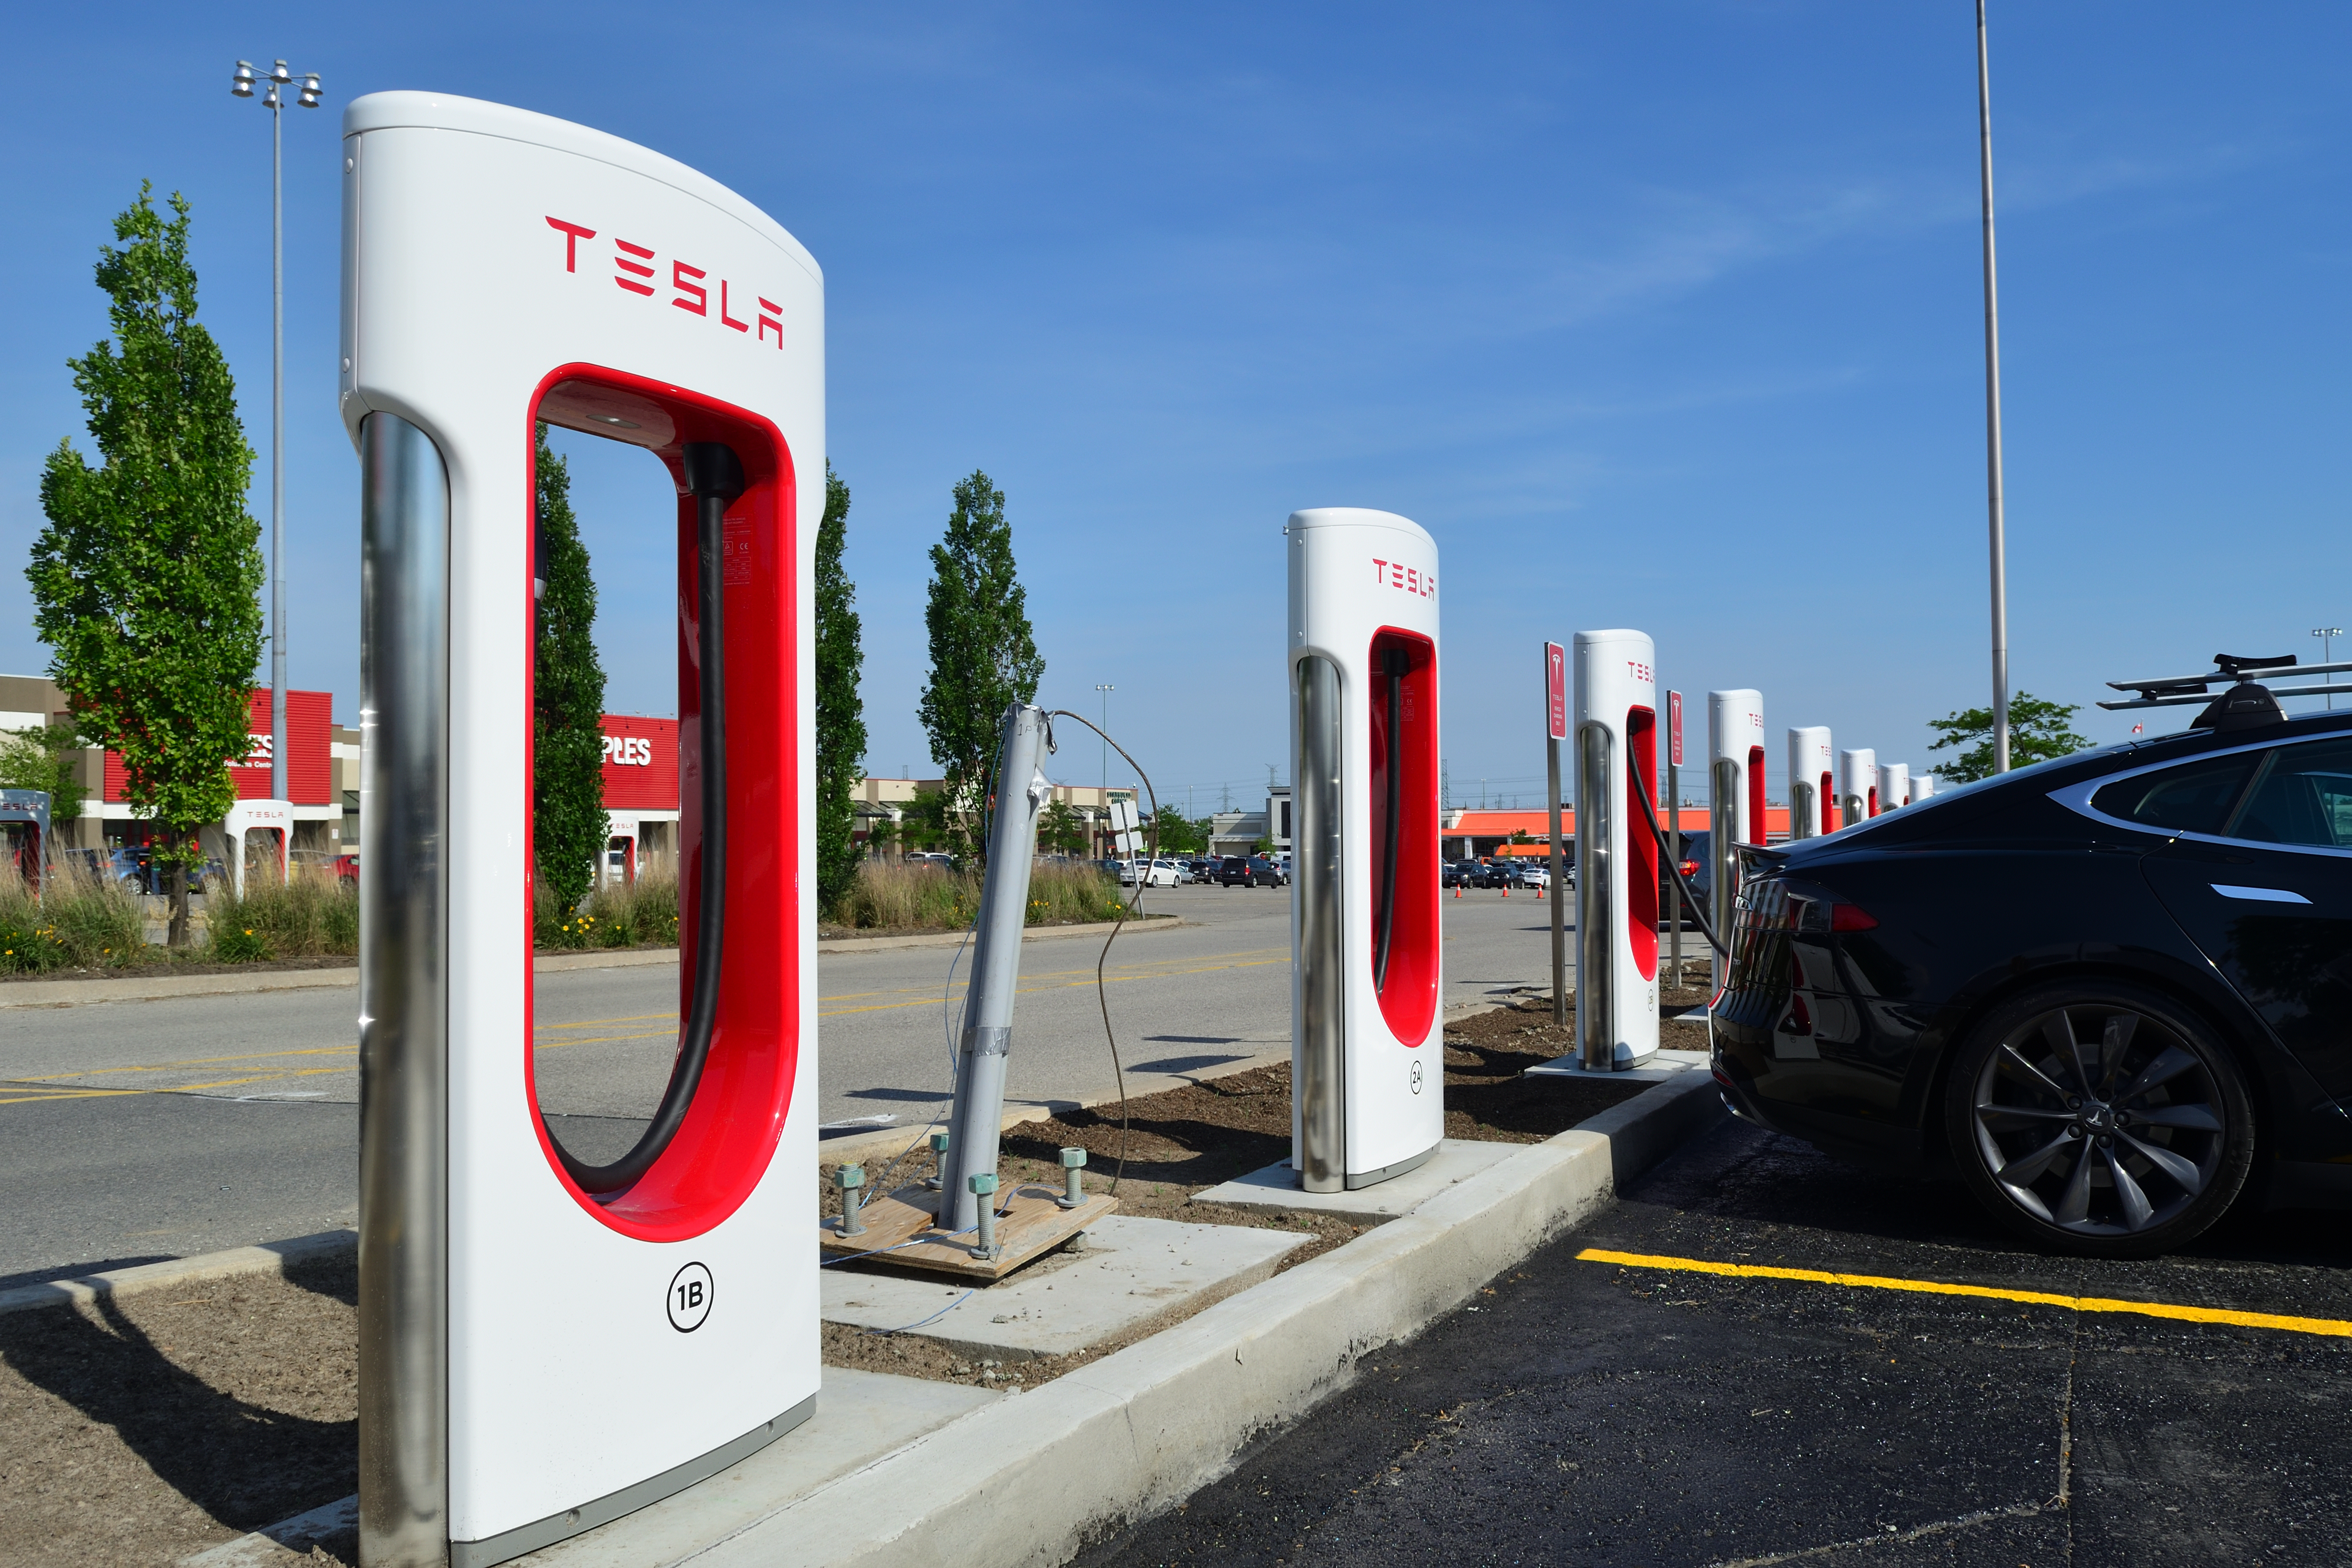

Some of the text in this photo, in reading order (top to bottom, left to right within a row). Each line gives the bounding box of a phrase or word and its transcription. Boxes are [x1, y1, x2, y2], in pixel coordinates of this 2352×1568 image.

[545, 215, 783, 350] TESLA
[1373, 558, 1434, 601] TESLA
[601, 736, 651, 766] PLES
[1412, 1070, 1421, 1084] 2A
[677, 1281, 703, 1311] 1B
